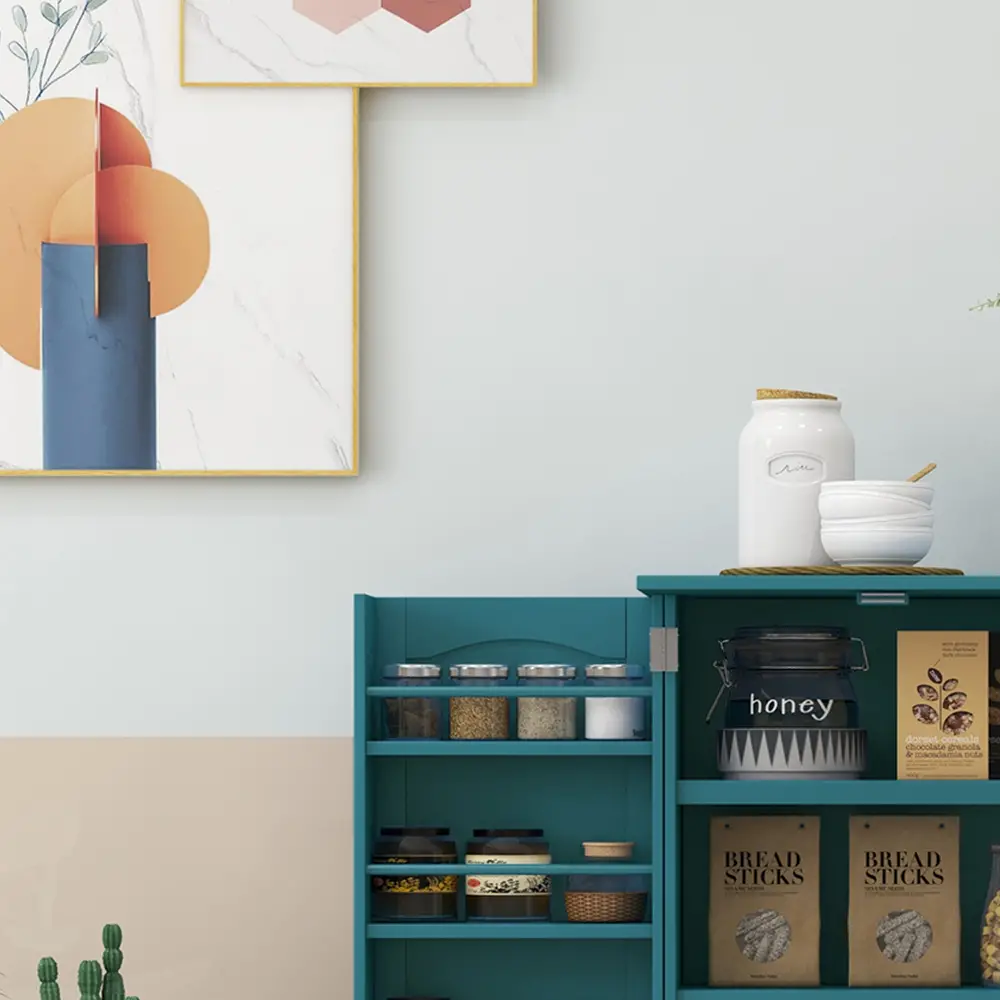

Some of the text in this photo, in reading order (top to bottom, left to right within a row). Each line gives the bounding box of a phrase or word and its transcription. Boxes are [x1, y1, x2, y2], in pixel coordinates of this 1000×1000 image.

[750, 693, 834, 721] honey
[906, 743, 981, 752] chocolate granola
[724, 851, 802, 868] BREAD
[864, 851, 942, 868] BREAD
[724, 868, 805, 885] STICKS
[864, 868, 945, 885] STICKS
